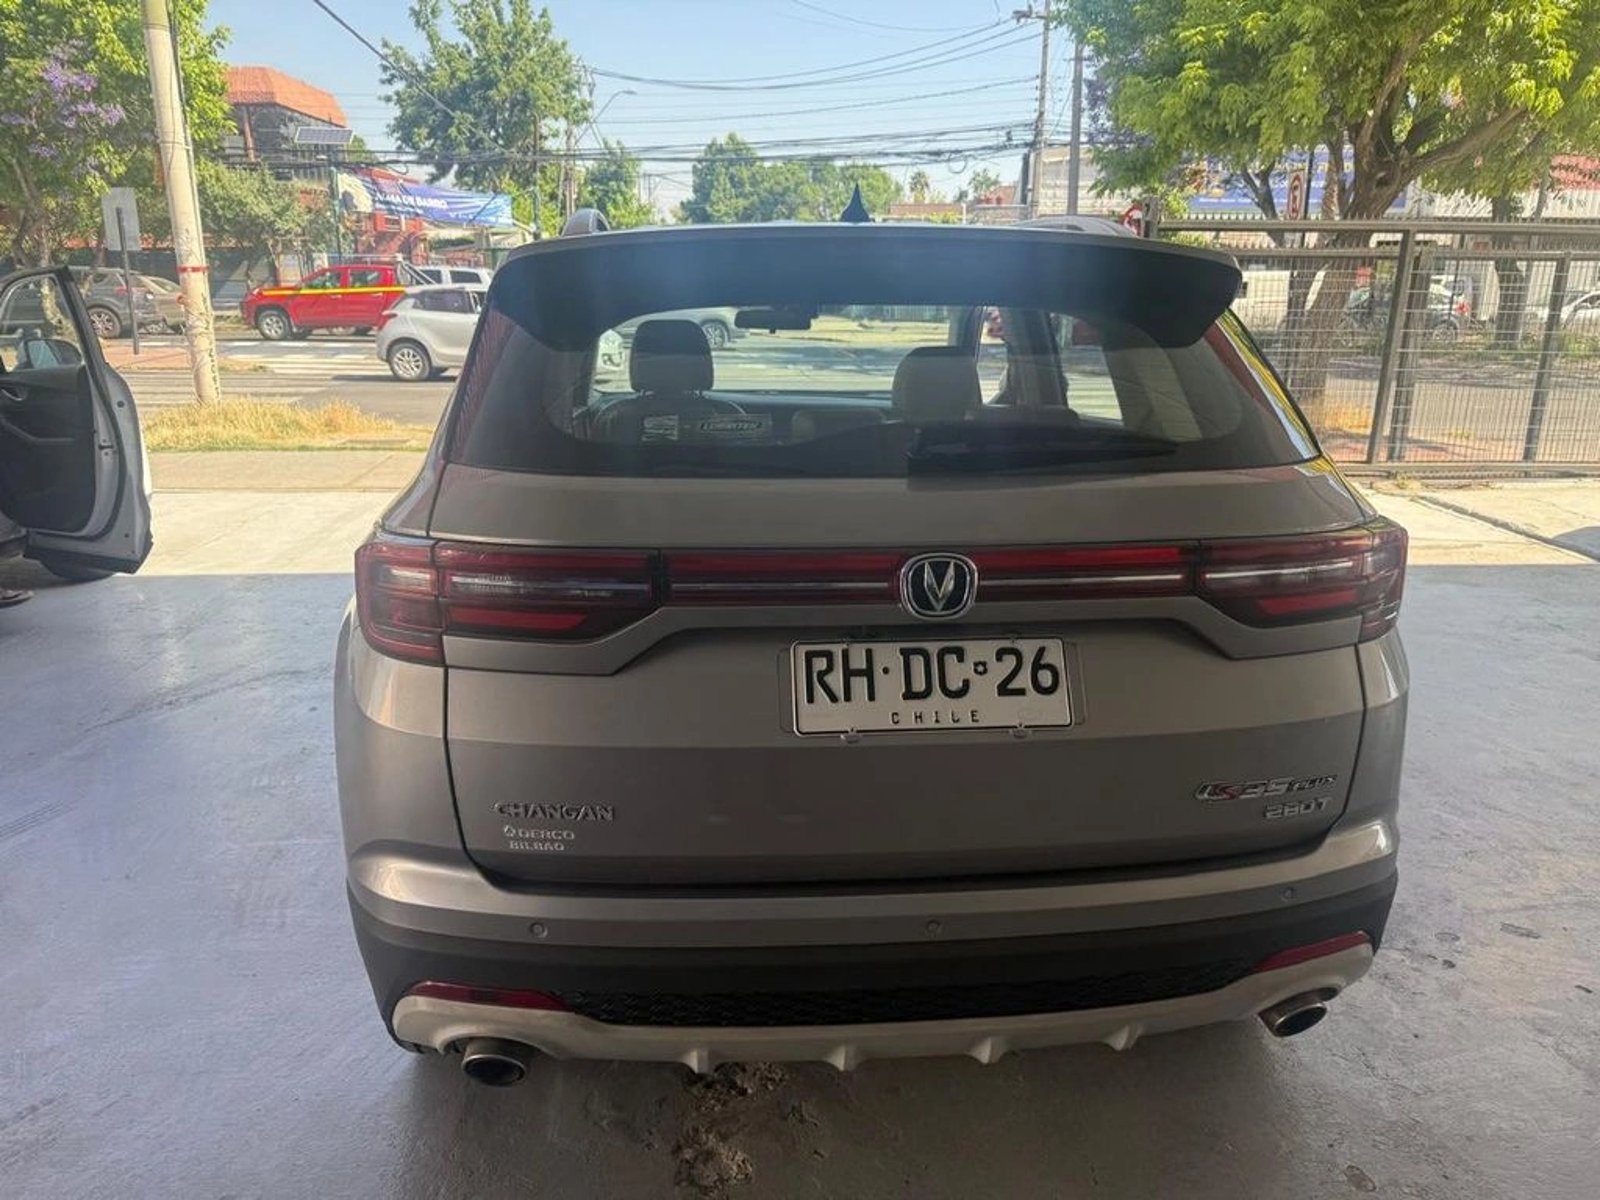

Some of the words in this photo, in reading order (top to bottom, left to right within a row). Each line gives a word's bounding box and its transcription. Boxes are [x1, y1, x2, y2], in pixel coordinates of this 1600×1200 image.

[890, 708, 981, 725] CHILE
[493, 801, 615, 821] CHANGAN
[1264, 798, 1331, 819] 280T
[517, 828, 576, 840] DERCO
[509, 840, 565, 851] BILBAO
